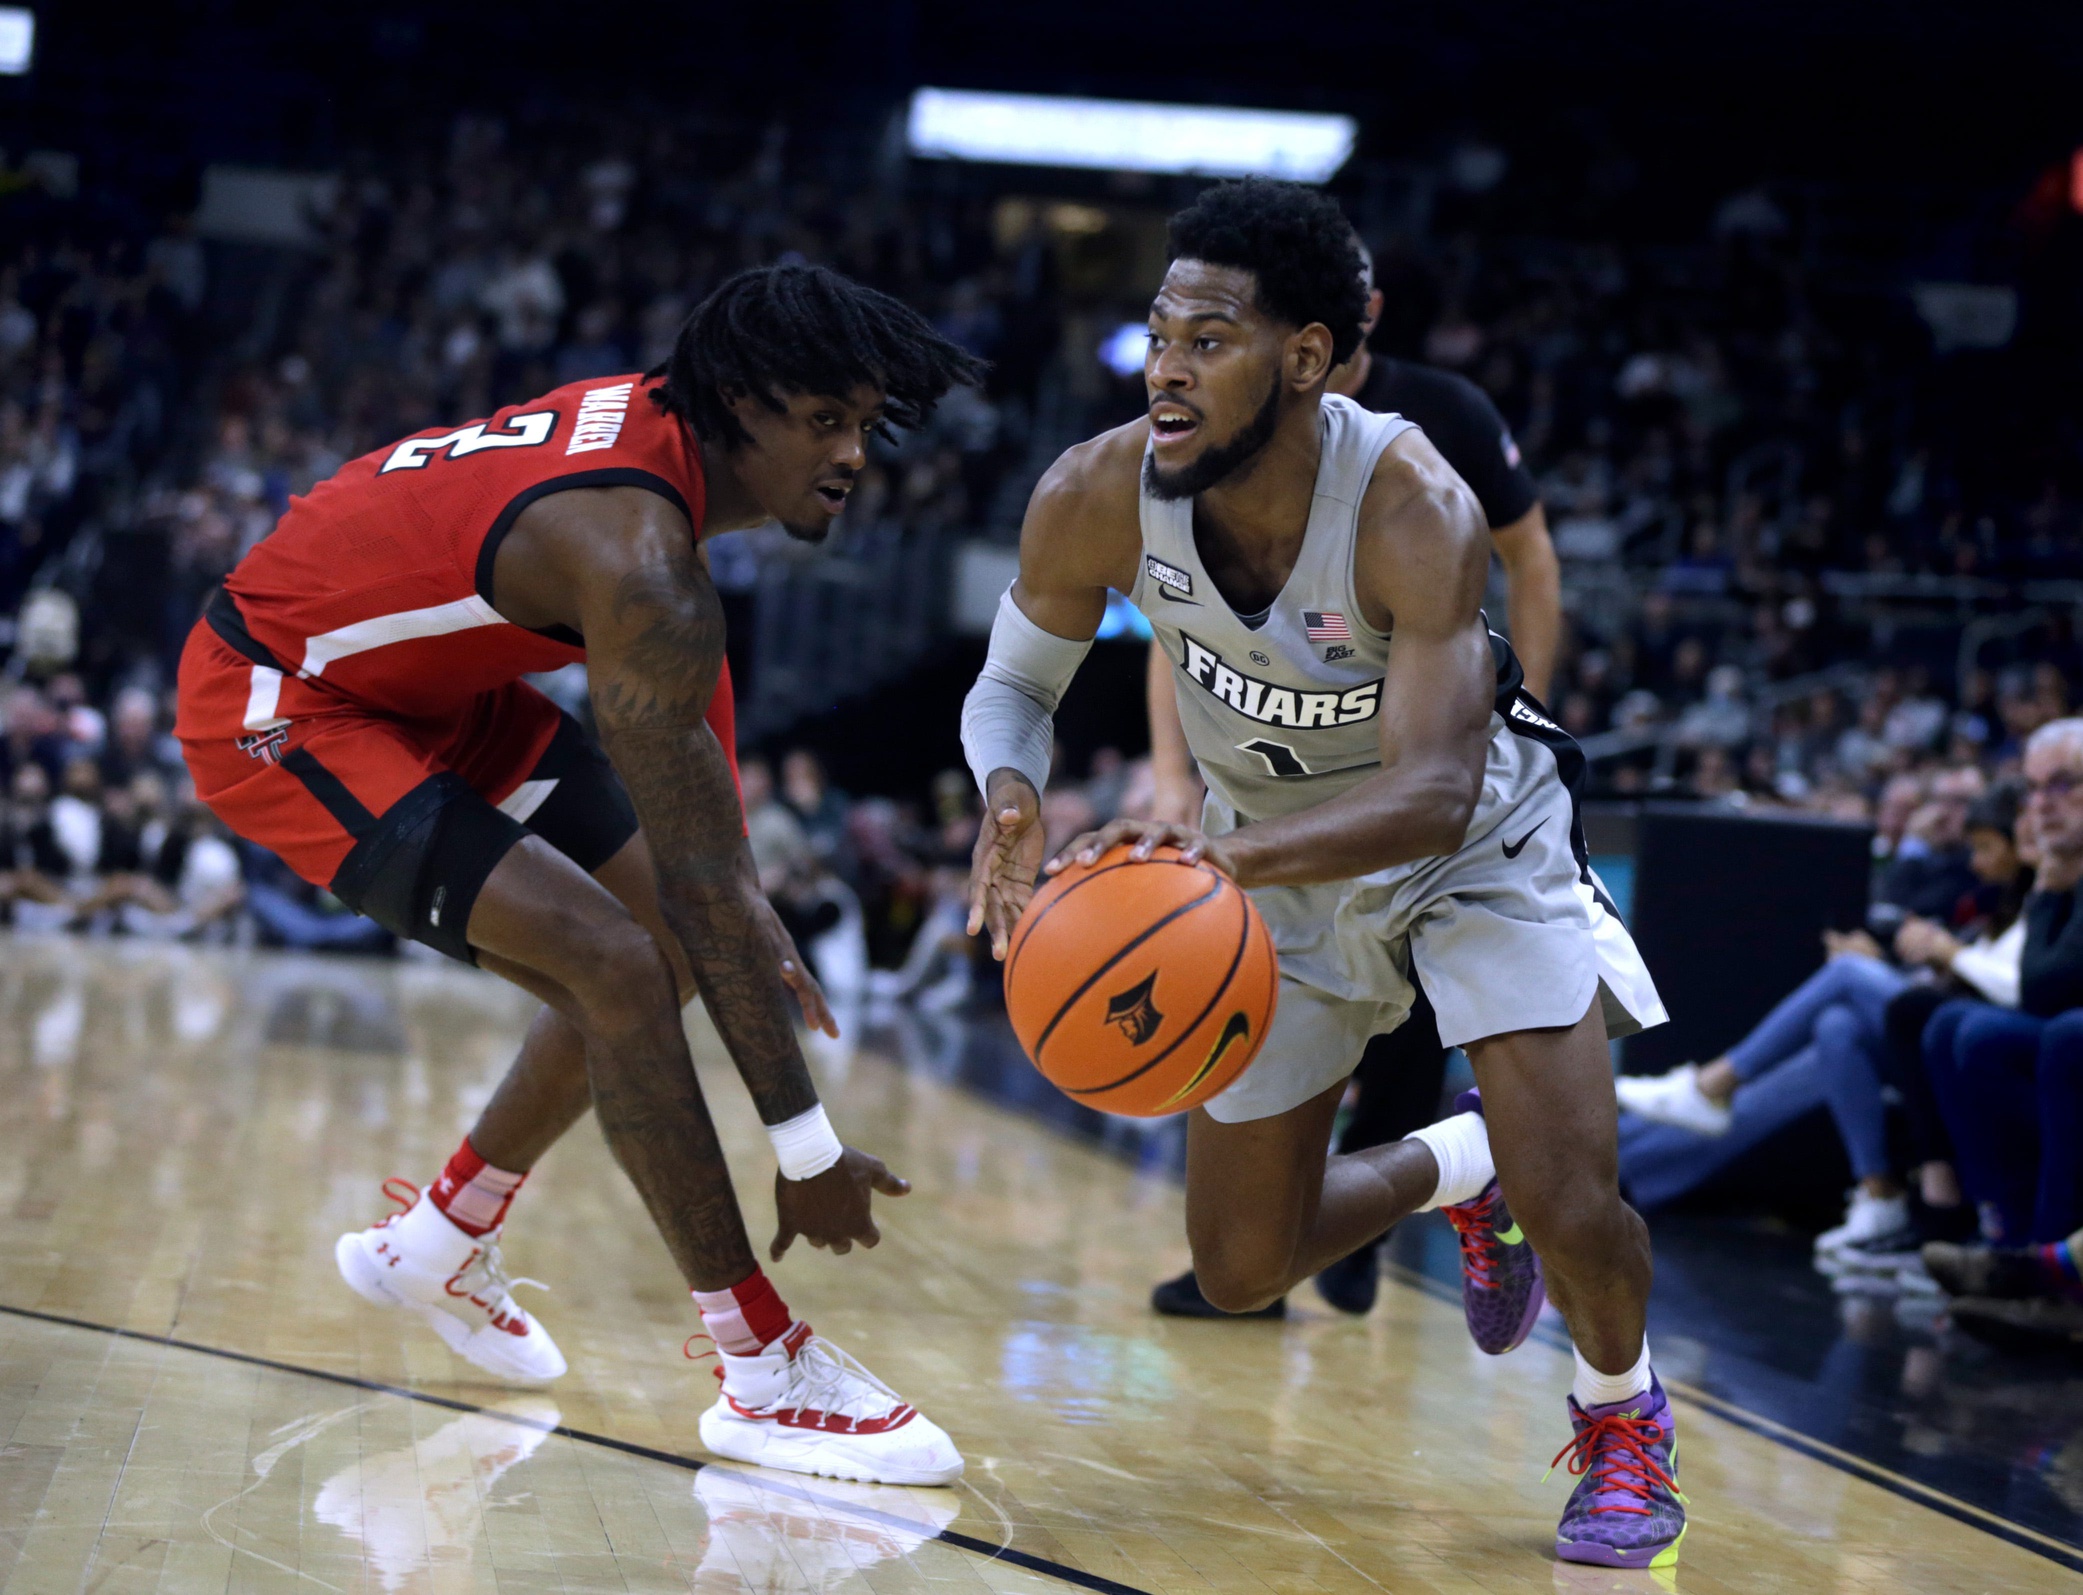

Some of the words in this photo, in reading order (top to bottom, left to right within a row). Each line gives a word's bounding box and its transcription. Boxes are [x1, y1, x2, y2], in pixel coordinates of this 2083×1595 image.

[565, 382, 634, 456] WARREN
[376, 409, 560, 476] 2
[1149, 569, 1191, 593] CHANGE
[1324, 648, 1356, 662] EAST
[1326, 644, 1347, 653] BIG
[1180, 630, 1384, 730] FRIARS
